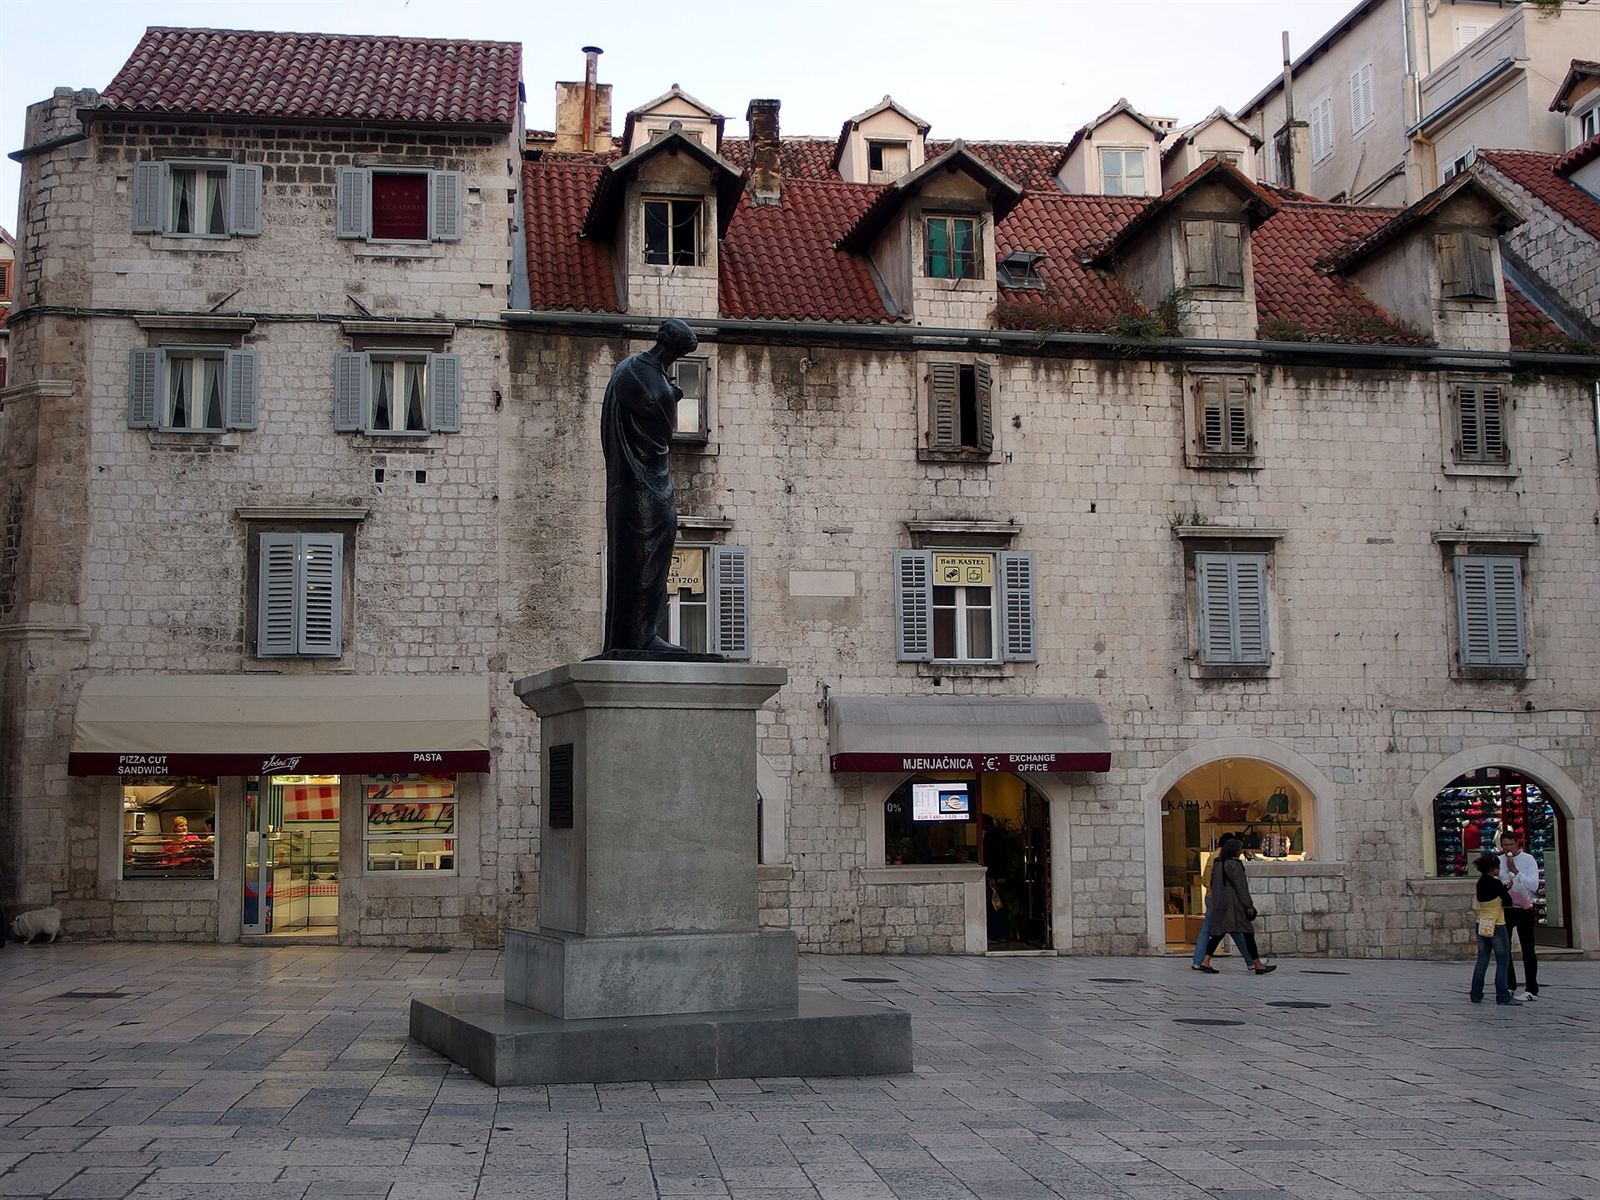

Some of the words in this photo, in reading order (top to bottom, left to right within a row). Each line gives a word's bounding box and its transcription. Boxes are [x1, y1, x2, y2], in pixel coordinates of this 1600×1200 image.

[119, 755, 146, 764] PIZZA
[147, 755, 168, 764] CUT
[413, 753, 442, 762] PASTA
[1009, 754, 1056, 763] EXCHANGE
[903, 756, 974, 770] MJENJAČNICA
[1017, 763, 1049, 772] OFFICE
[118, 766, 169, 774] SANDWICH
[1167, 800, 1212, 810] KARLA
